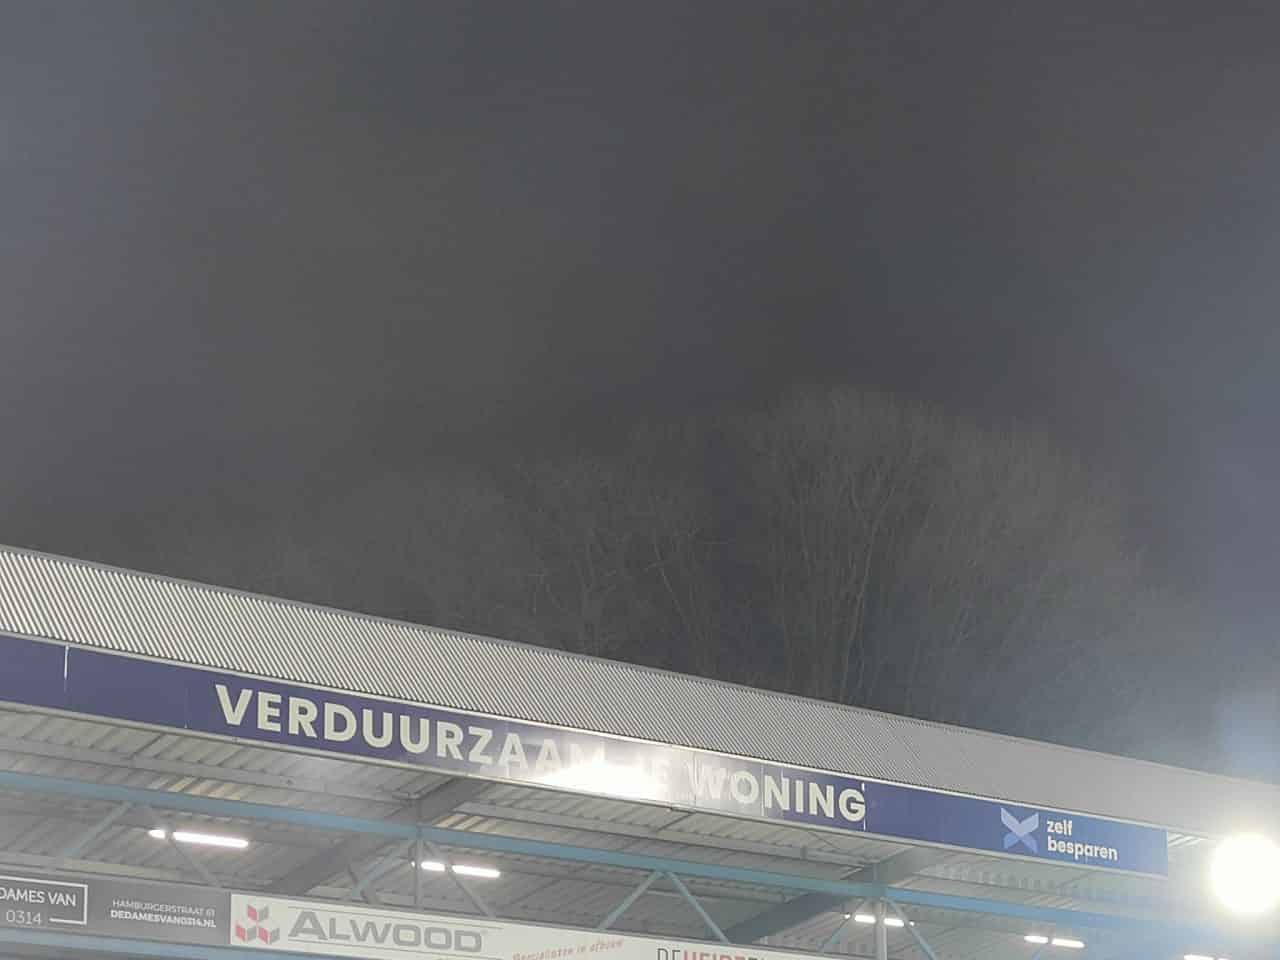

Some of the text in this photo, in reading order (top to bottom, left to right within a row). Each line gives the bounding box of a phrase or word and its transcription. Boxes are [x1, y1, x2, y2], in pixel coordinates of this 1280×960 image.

[687, 759, 866, 821] WONING
[1047, 820, 1072, 835] zelf
[1047, 836, 1118, 861] besparen
[48, 892, 77, 907] VAN
[6, 909, 42, 925] 0314
[288, 911, 482, 952] ALWOOD
